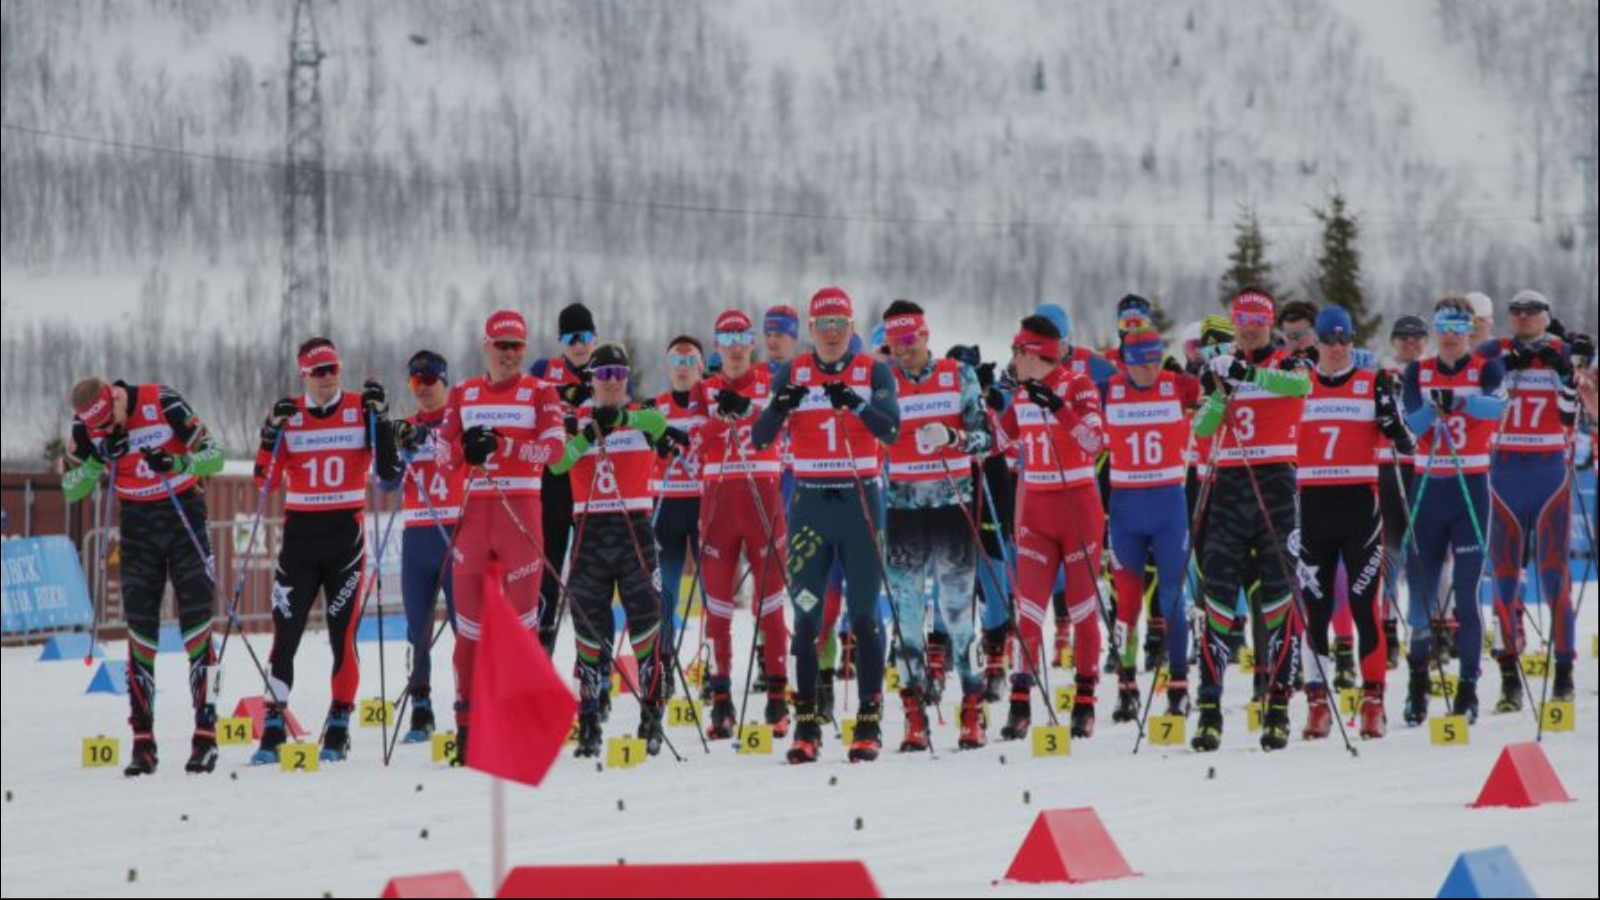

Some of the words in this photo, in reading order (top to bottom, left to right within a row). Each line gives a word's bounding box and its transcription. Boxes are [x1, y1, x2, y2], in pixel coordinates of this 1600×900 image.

[1235, 406, 1255, 441] 3
[1508, 396, 1548, 428] 17
[819, 417, 837, 453] 1
[1126, 430, 1162, 465] 16
[1319, 426, 1341, 461] 7
[1024, 431, 1051, 466] 11
[302, 455, 345, 488] 10
[596, 459, 617, 494] 8
[417, 468, 448, 501] 14
[1352, 544, 1384, 596] RUSSIA
[327, 570, 362, 617] RUSSIA
[364, 707, 387, 723] 20
[675, 706, 696, 723] 18
[1550, 707, 1562, 724] 9
[223, 724, 246, 740] 14
[747, 731, 760, 748] 6
[1044, 735, 1058, 751] 3
[1161, 723, 1173, 739] 7
[1443, 724, 1456, 741] 5
[90, 746, 113, 762] 10
[293, 751, 306, 769] 2
[622, 747, 630, 763] 1
